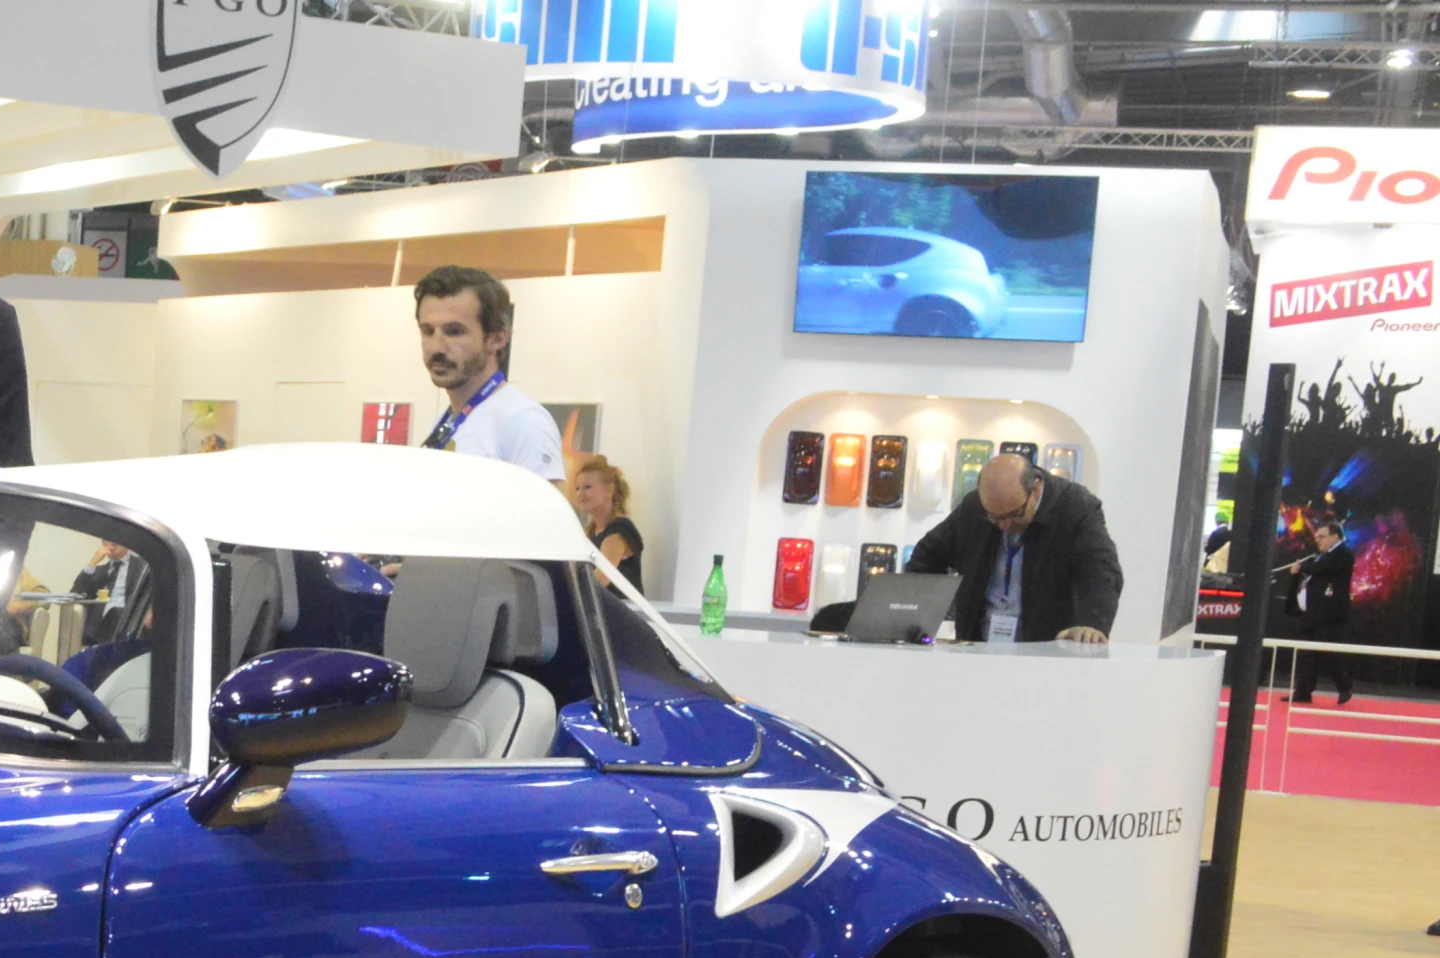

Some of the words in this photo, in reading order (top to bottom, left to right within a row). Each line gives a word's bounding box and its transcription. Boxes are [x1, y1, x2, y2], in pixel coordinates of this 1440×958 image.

[1273, 267, 1430, 320] MIXTRAX
[1369, 318, 1440, 333] Pioneer
[1008, 807, 1183, 842] AUTOMOBILES
